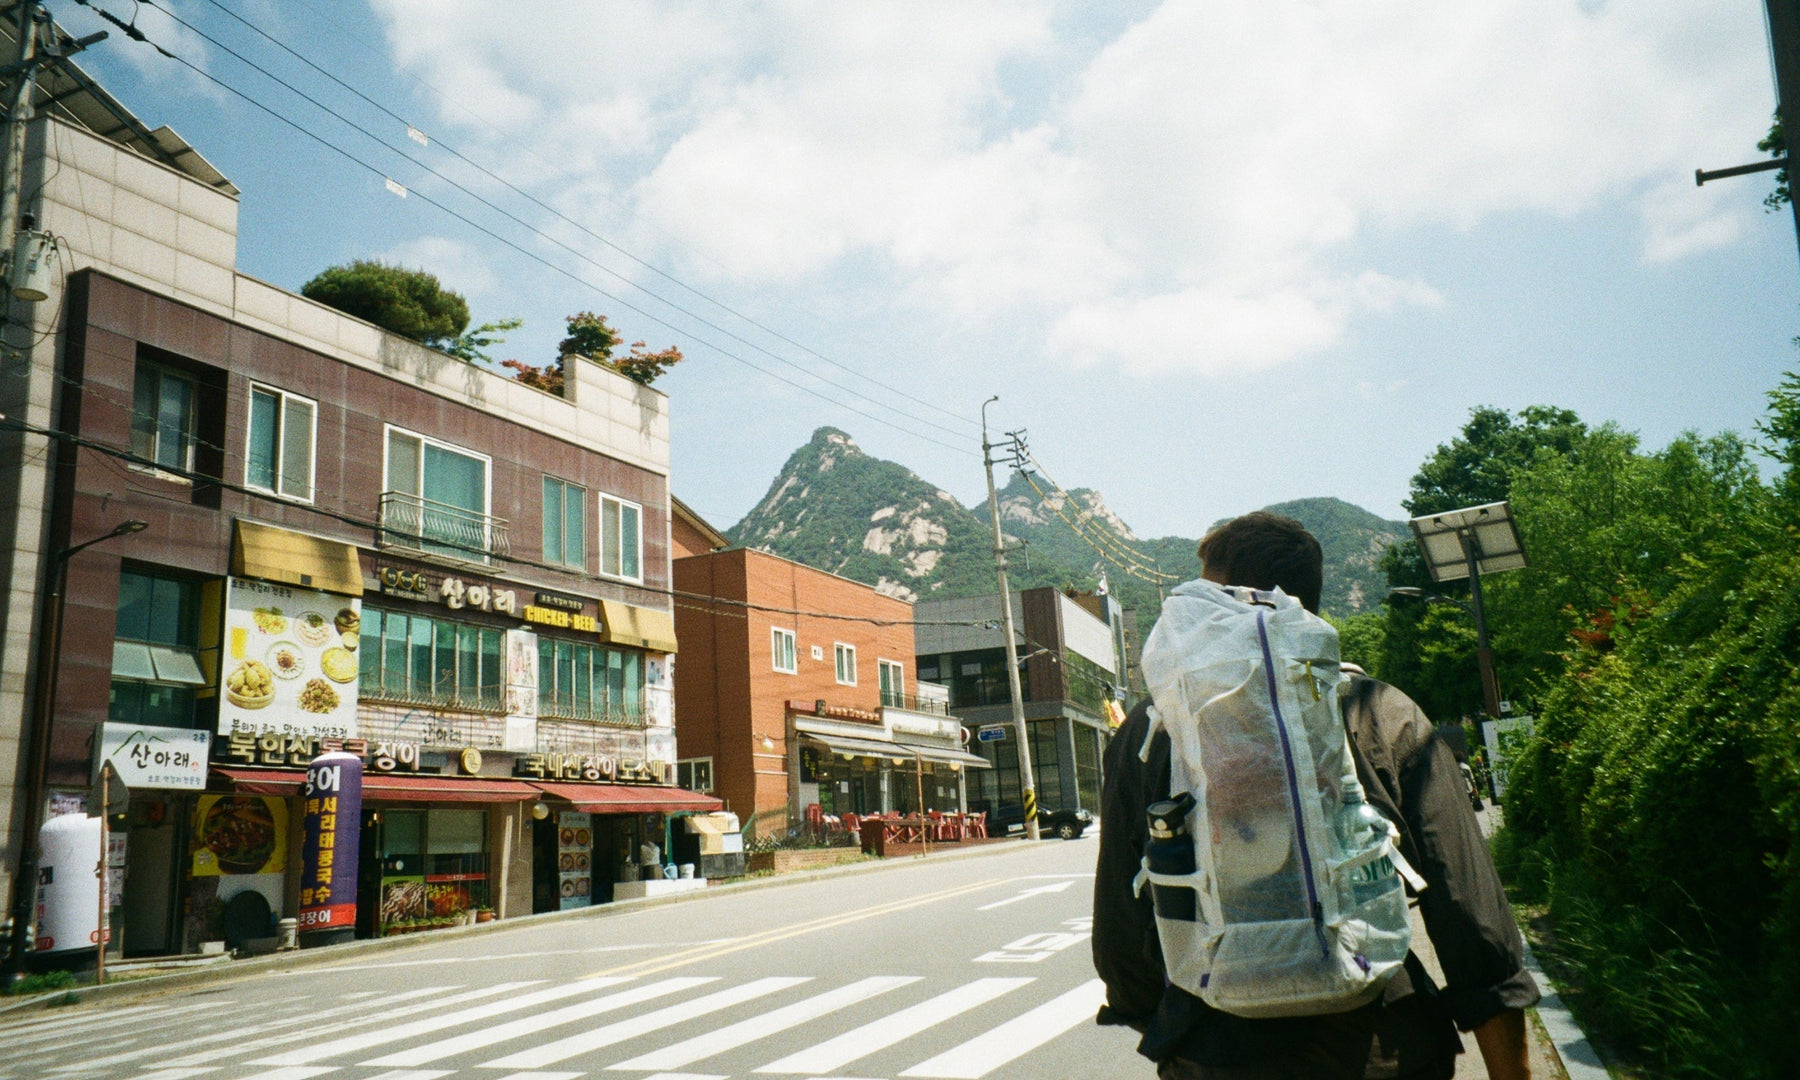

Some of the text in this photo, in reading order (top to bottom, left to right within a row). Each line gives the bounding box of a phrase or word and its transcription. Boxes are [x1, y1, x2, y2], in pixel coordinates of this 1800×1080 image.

[440, 577, 516, 615] 산아래
[523, 604, 596, 632] CHICKEN BEER
[193, 733, 206, 743] 2층
[130, 743, 189, 769] 산아래
[315, 796, 338, 904] 서리태콩국수
